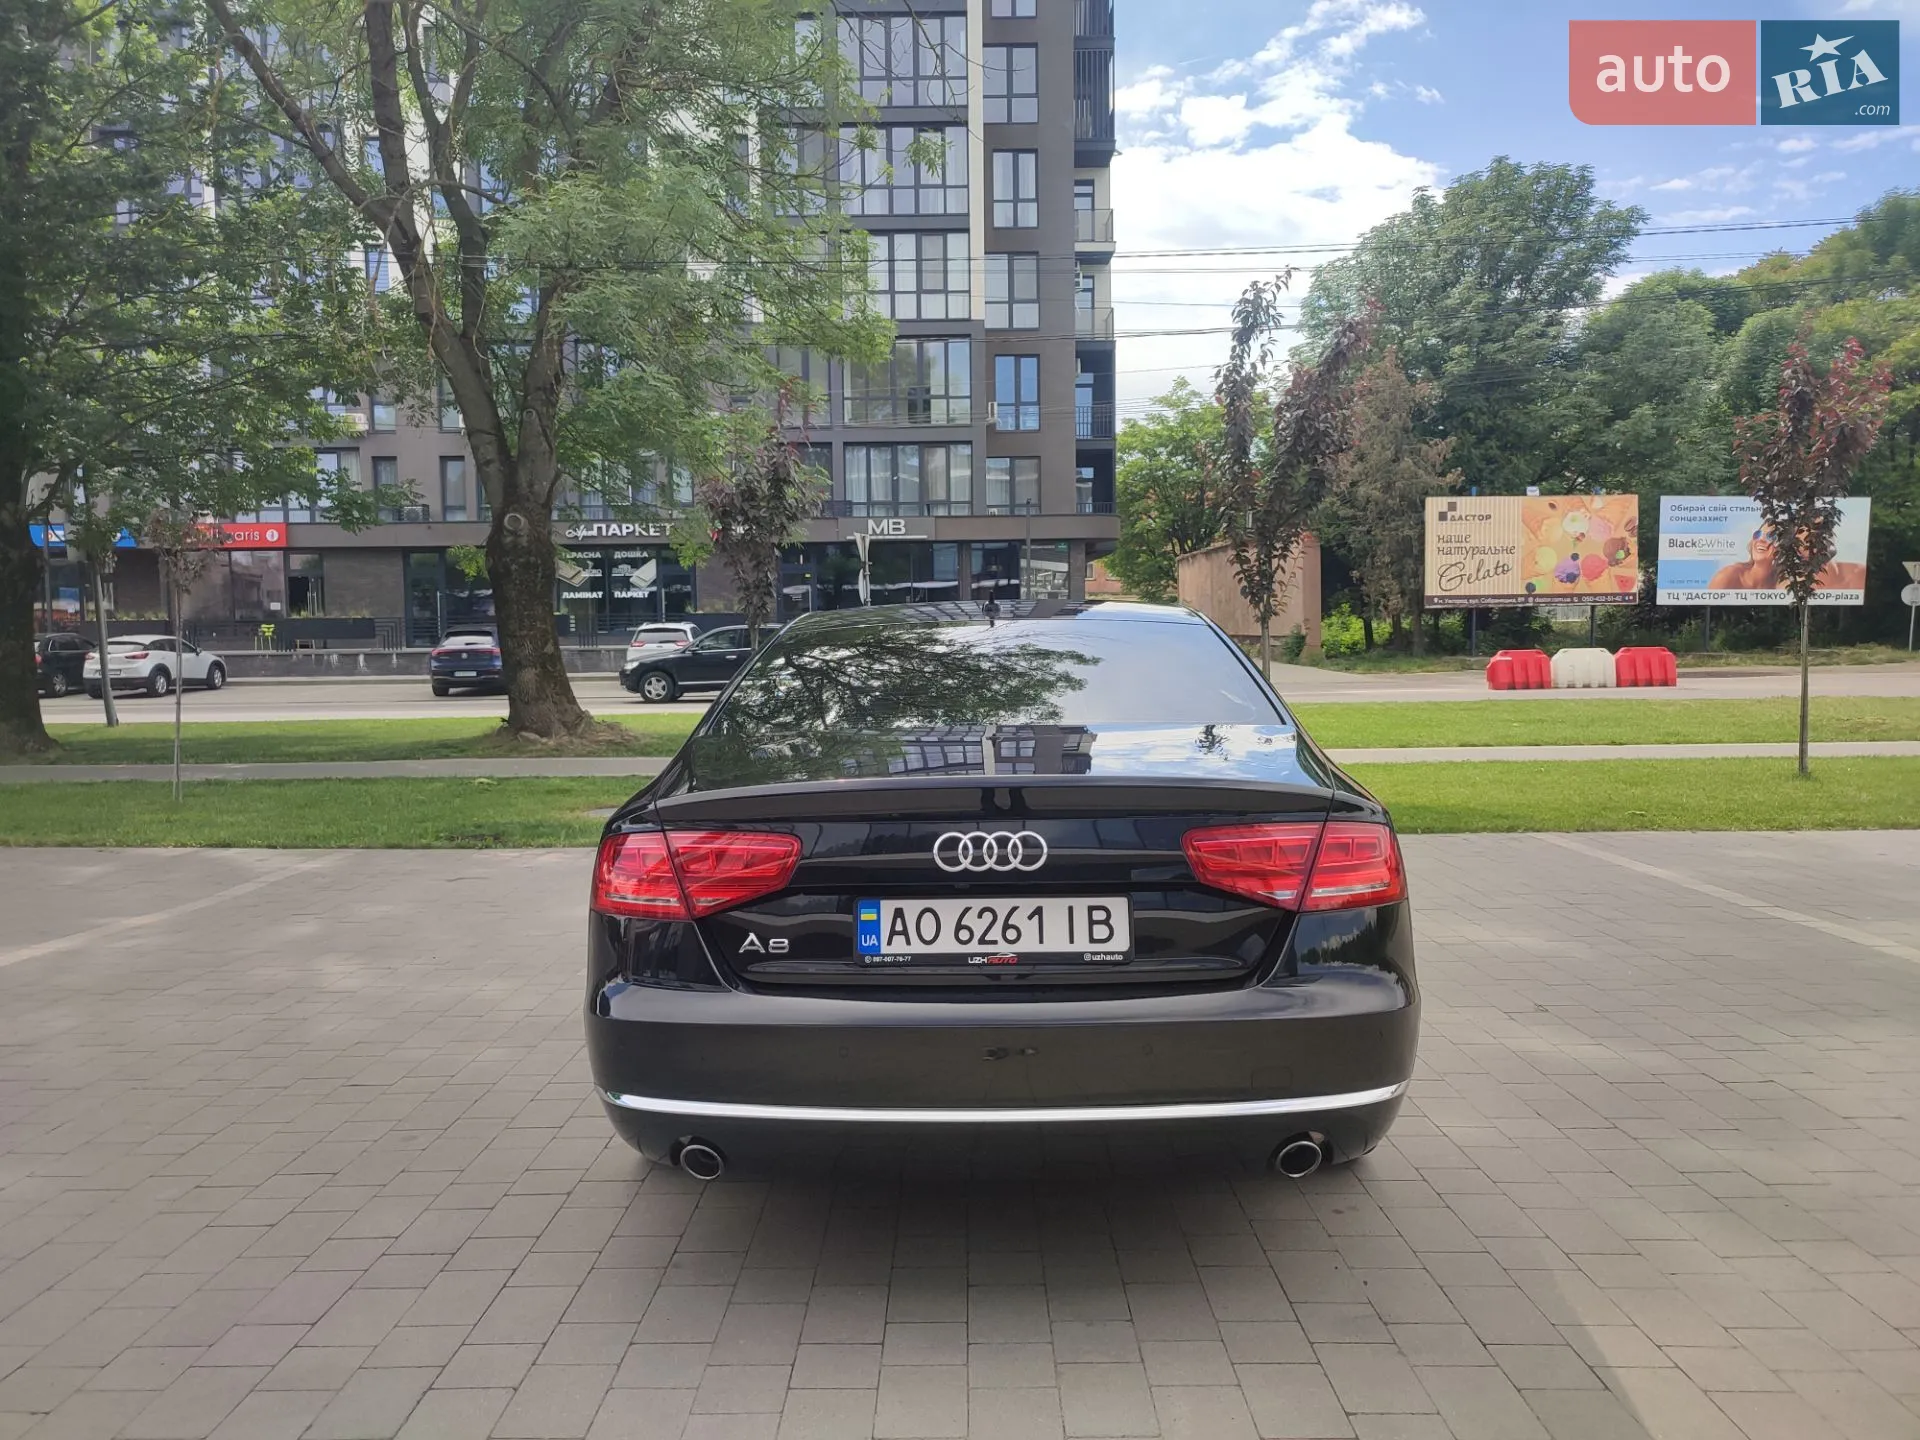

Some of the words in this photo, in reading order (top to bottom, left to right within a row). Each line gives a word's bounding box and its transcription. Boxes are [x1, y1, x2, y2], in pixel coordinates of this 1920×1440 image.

[1670, 504, 1706, 513] Обирай
[1708, 504, 1727, 512] свій
[1437, 534, 1471, 543] наше
[1668, 538, 1736, 548] Black&White
[614, 551, 648, 559] ДОШКА
[1437, 545, 1516, 560] натуральне
[1437, 559, 1514, 592] Gelato
[1666, 592, 1680, 600] ТЦ
[1735, 592, 1748, 600] ТЦ
[886, 907, 941, 946] AO
[953, 905, 1044, 946] 6261
[1068, 905, 1115, 945] IB
[739, 932, 789, 953] A8
[861, 934, 879, 946] UA
